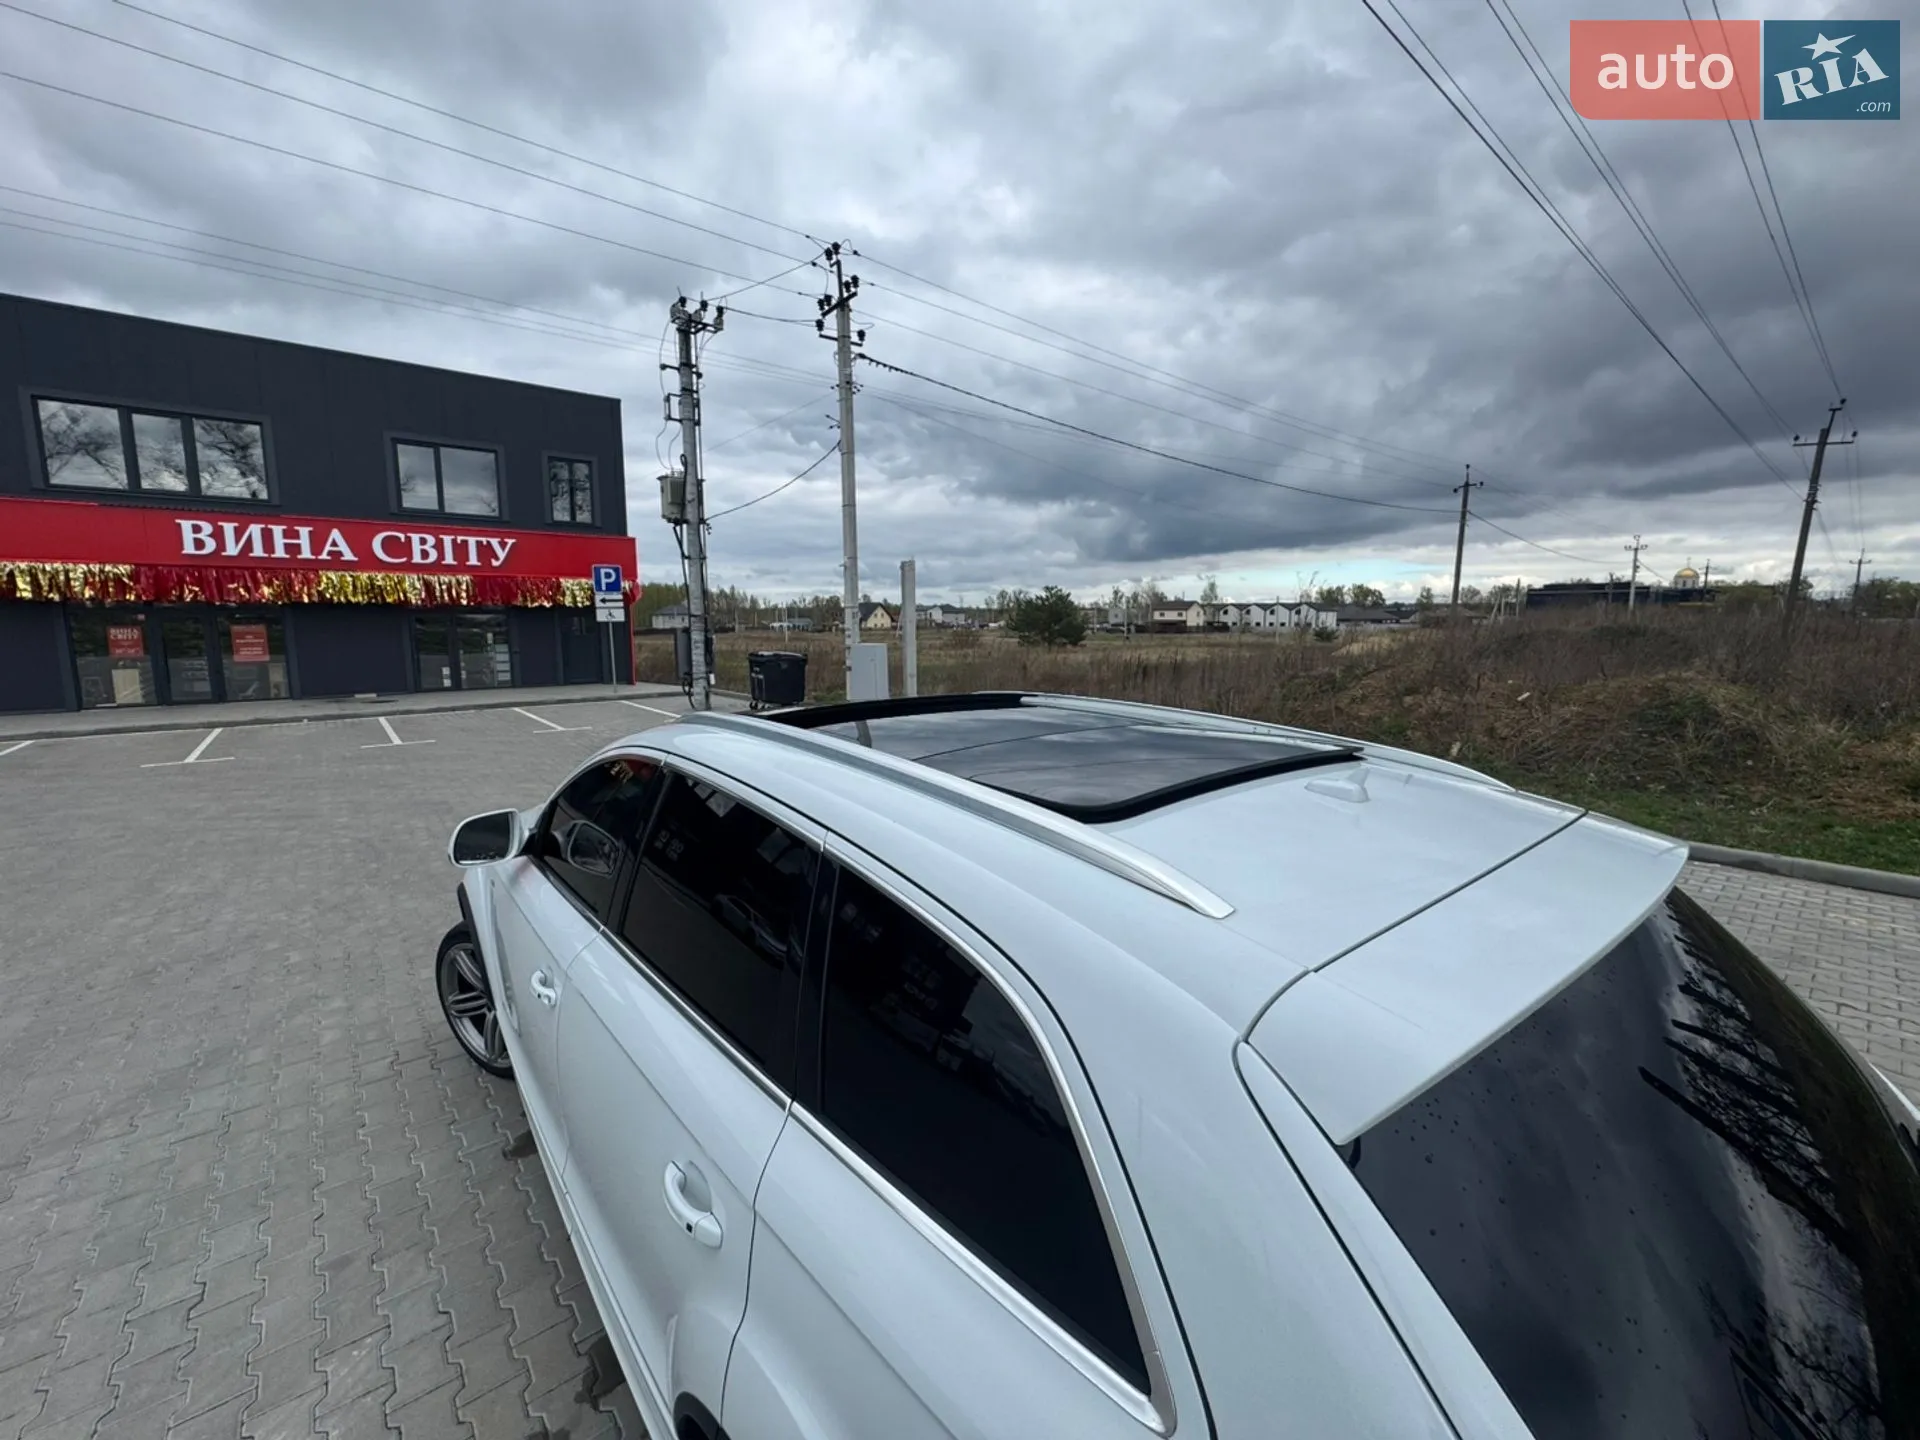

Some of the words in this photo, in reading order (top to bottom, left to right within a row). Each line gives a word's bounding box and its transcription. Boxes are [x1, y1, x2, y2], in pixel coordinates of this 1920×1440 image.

[174, 518, 359, 561] ВИНА
[371, 530, 517, 567] СВІТУ
[600, 567, 617, 591] P
